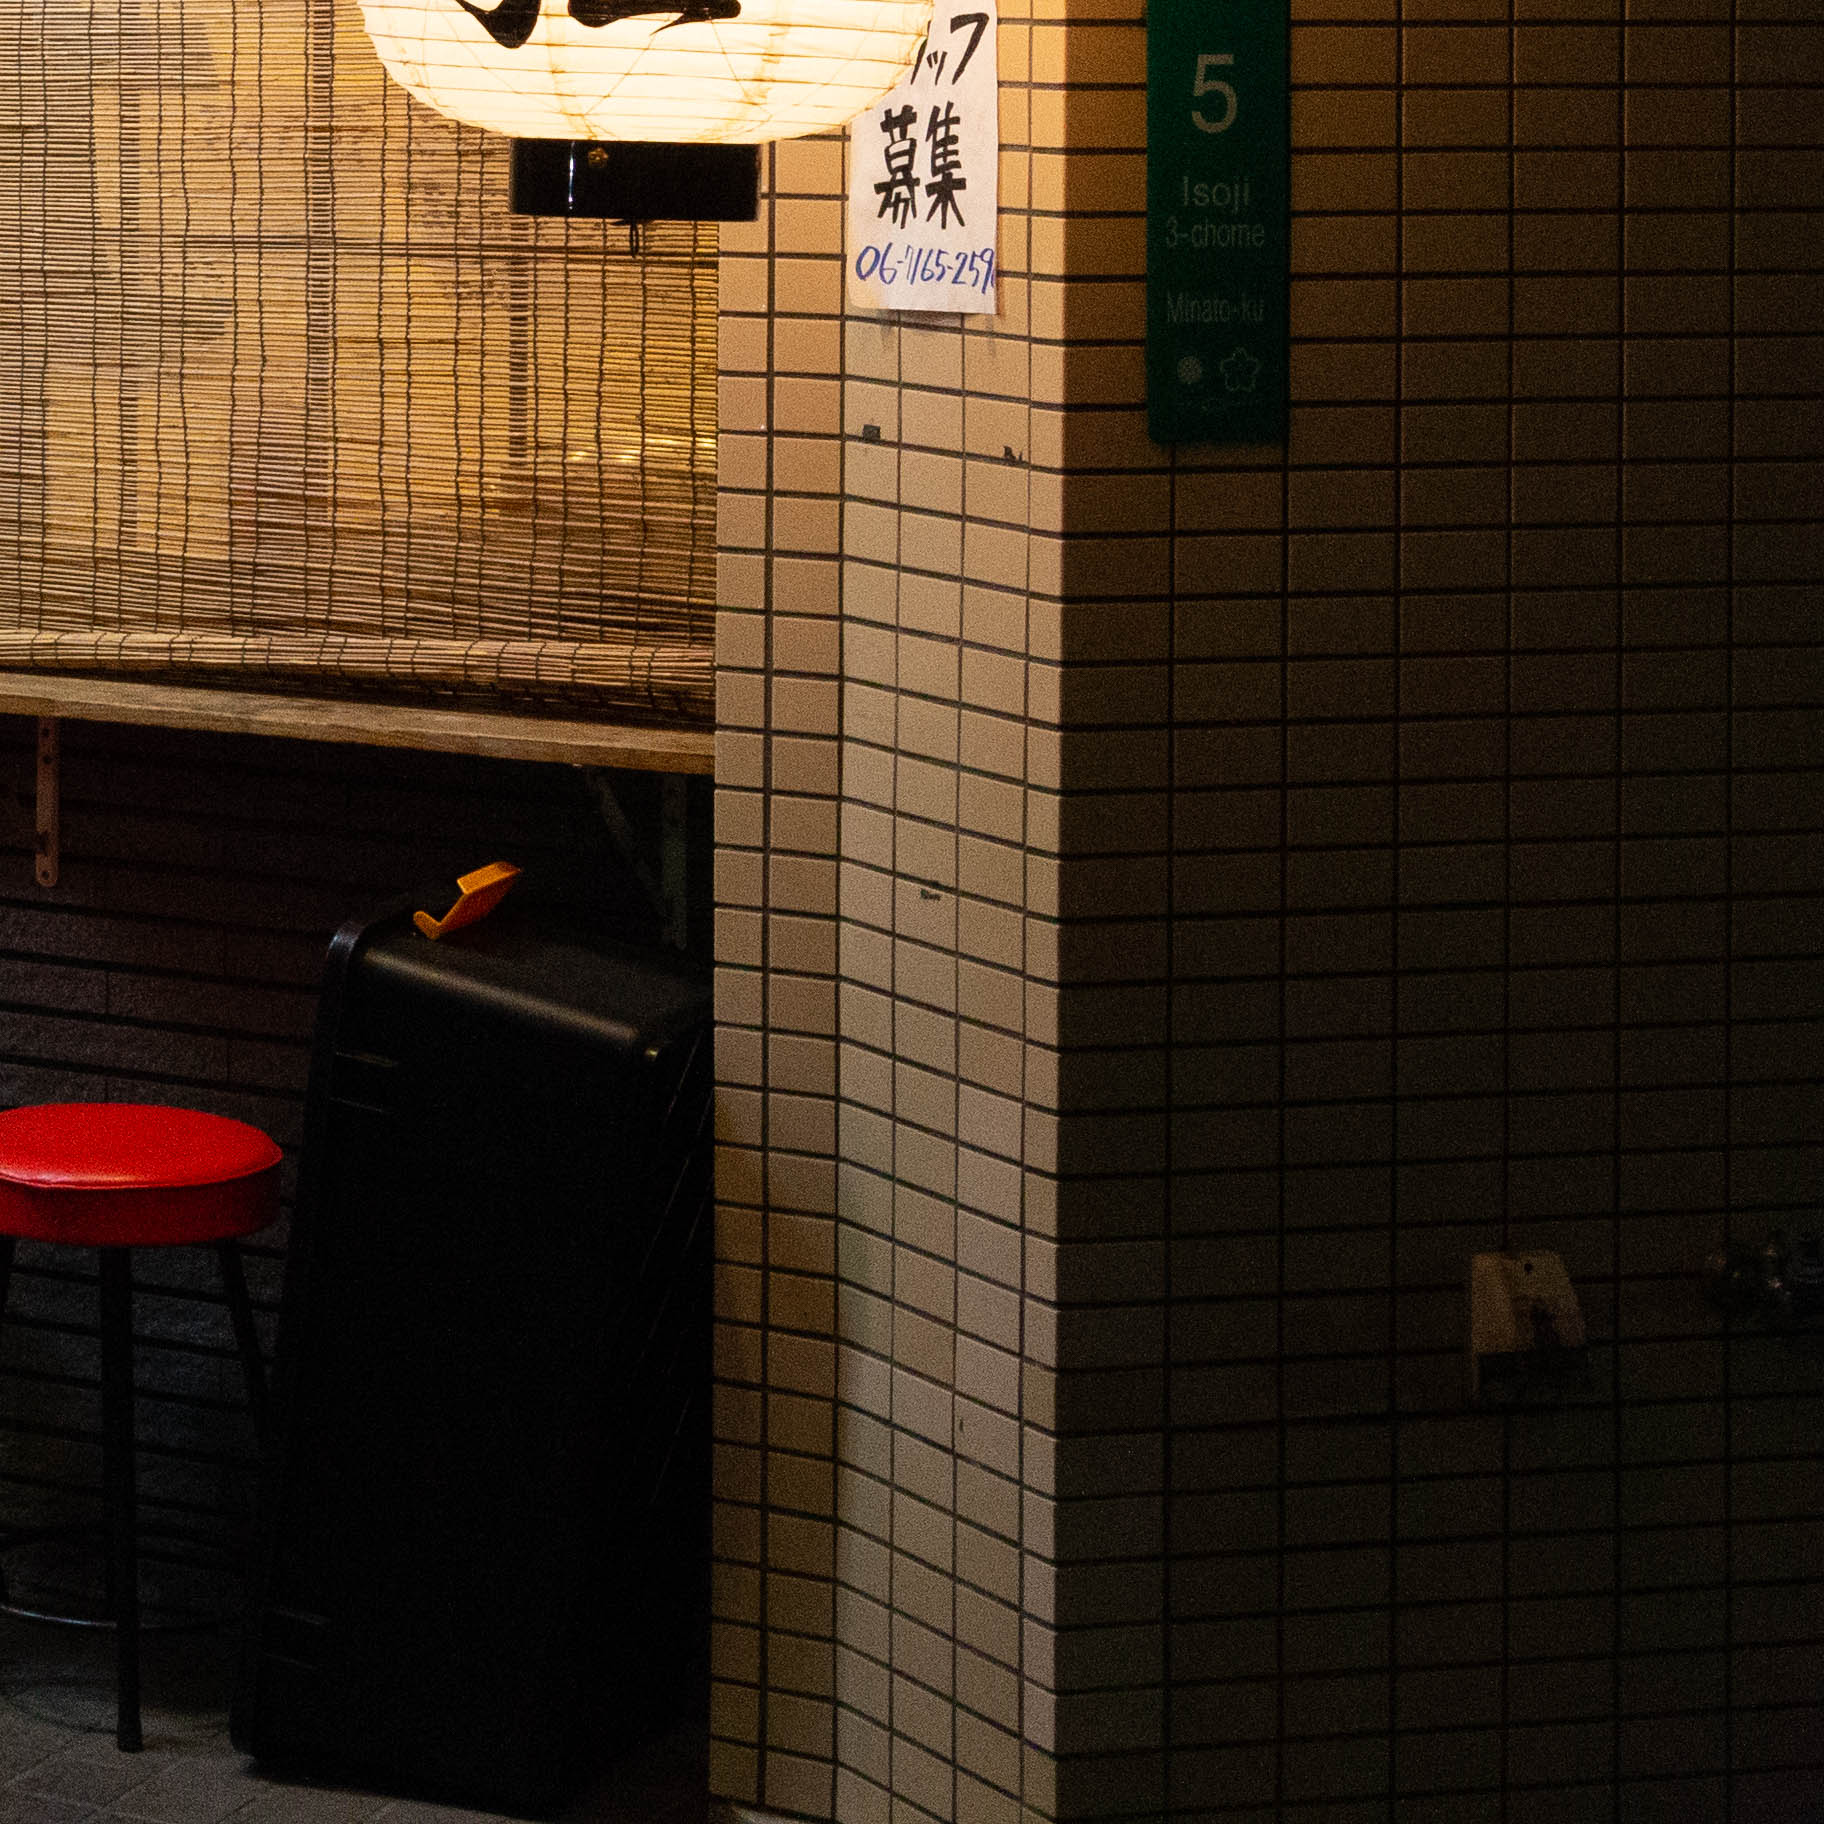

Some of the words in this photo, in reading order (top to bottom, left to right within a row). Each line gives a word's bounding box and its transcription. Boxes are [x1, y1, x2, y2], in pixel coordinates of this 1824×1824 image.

[1190, 53, 1239, 135] 5
[873, 100, 967, 230] 募集
[1182, 175, 1251, 213] Isoji
[1165, 215, 1266, 250] 3-chome
[1166, 289, 1266, 324] Minato-ku
